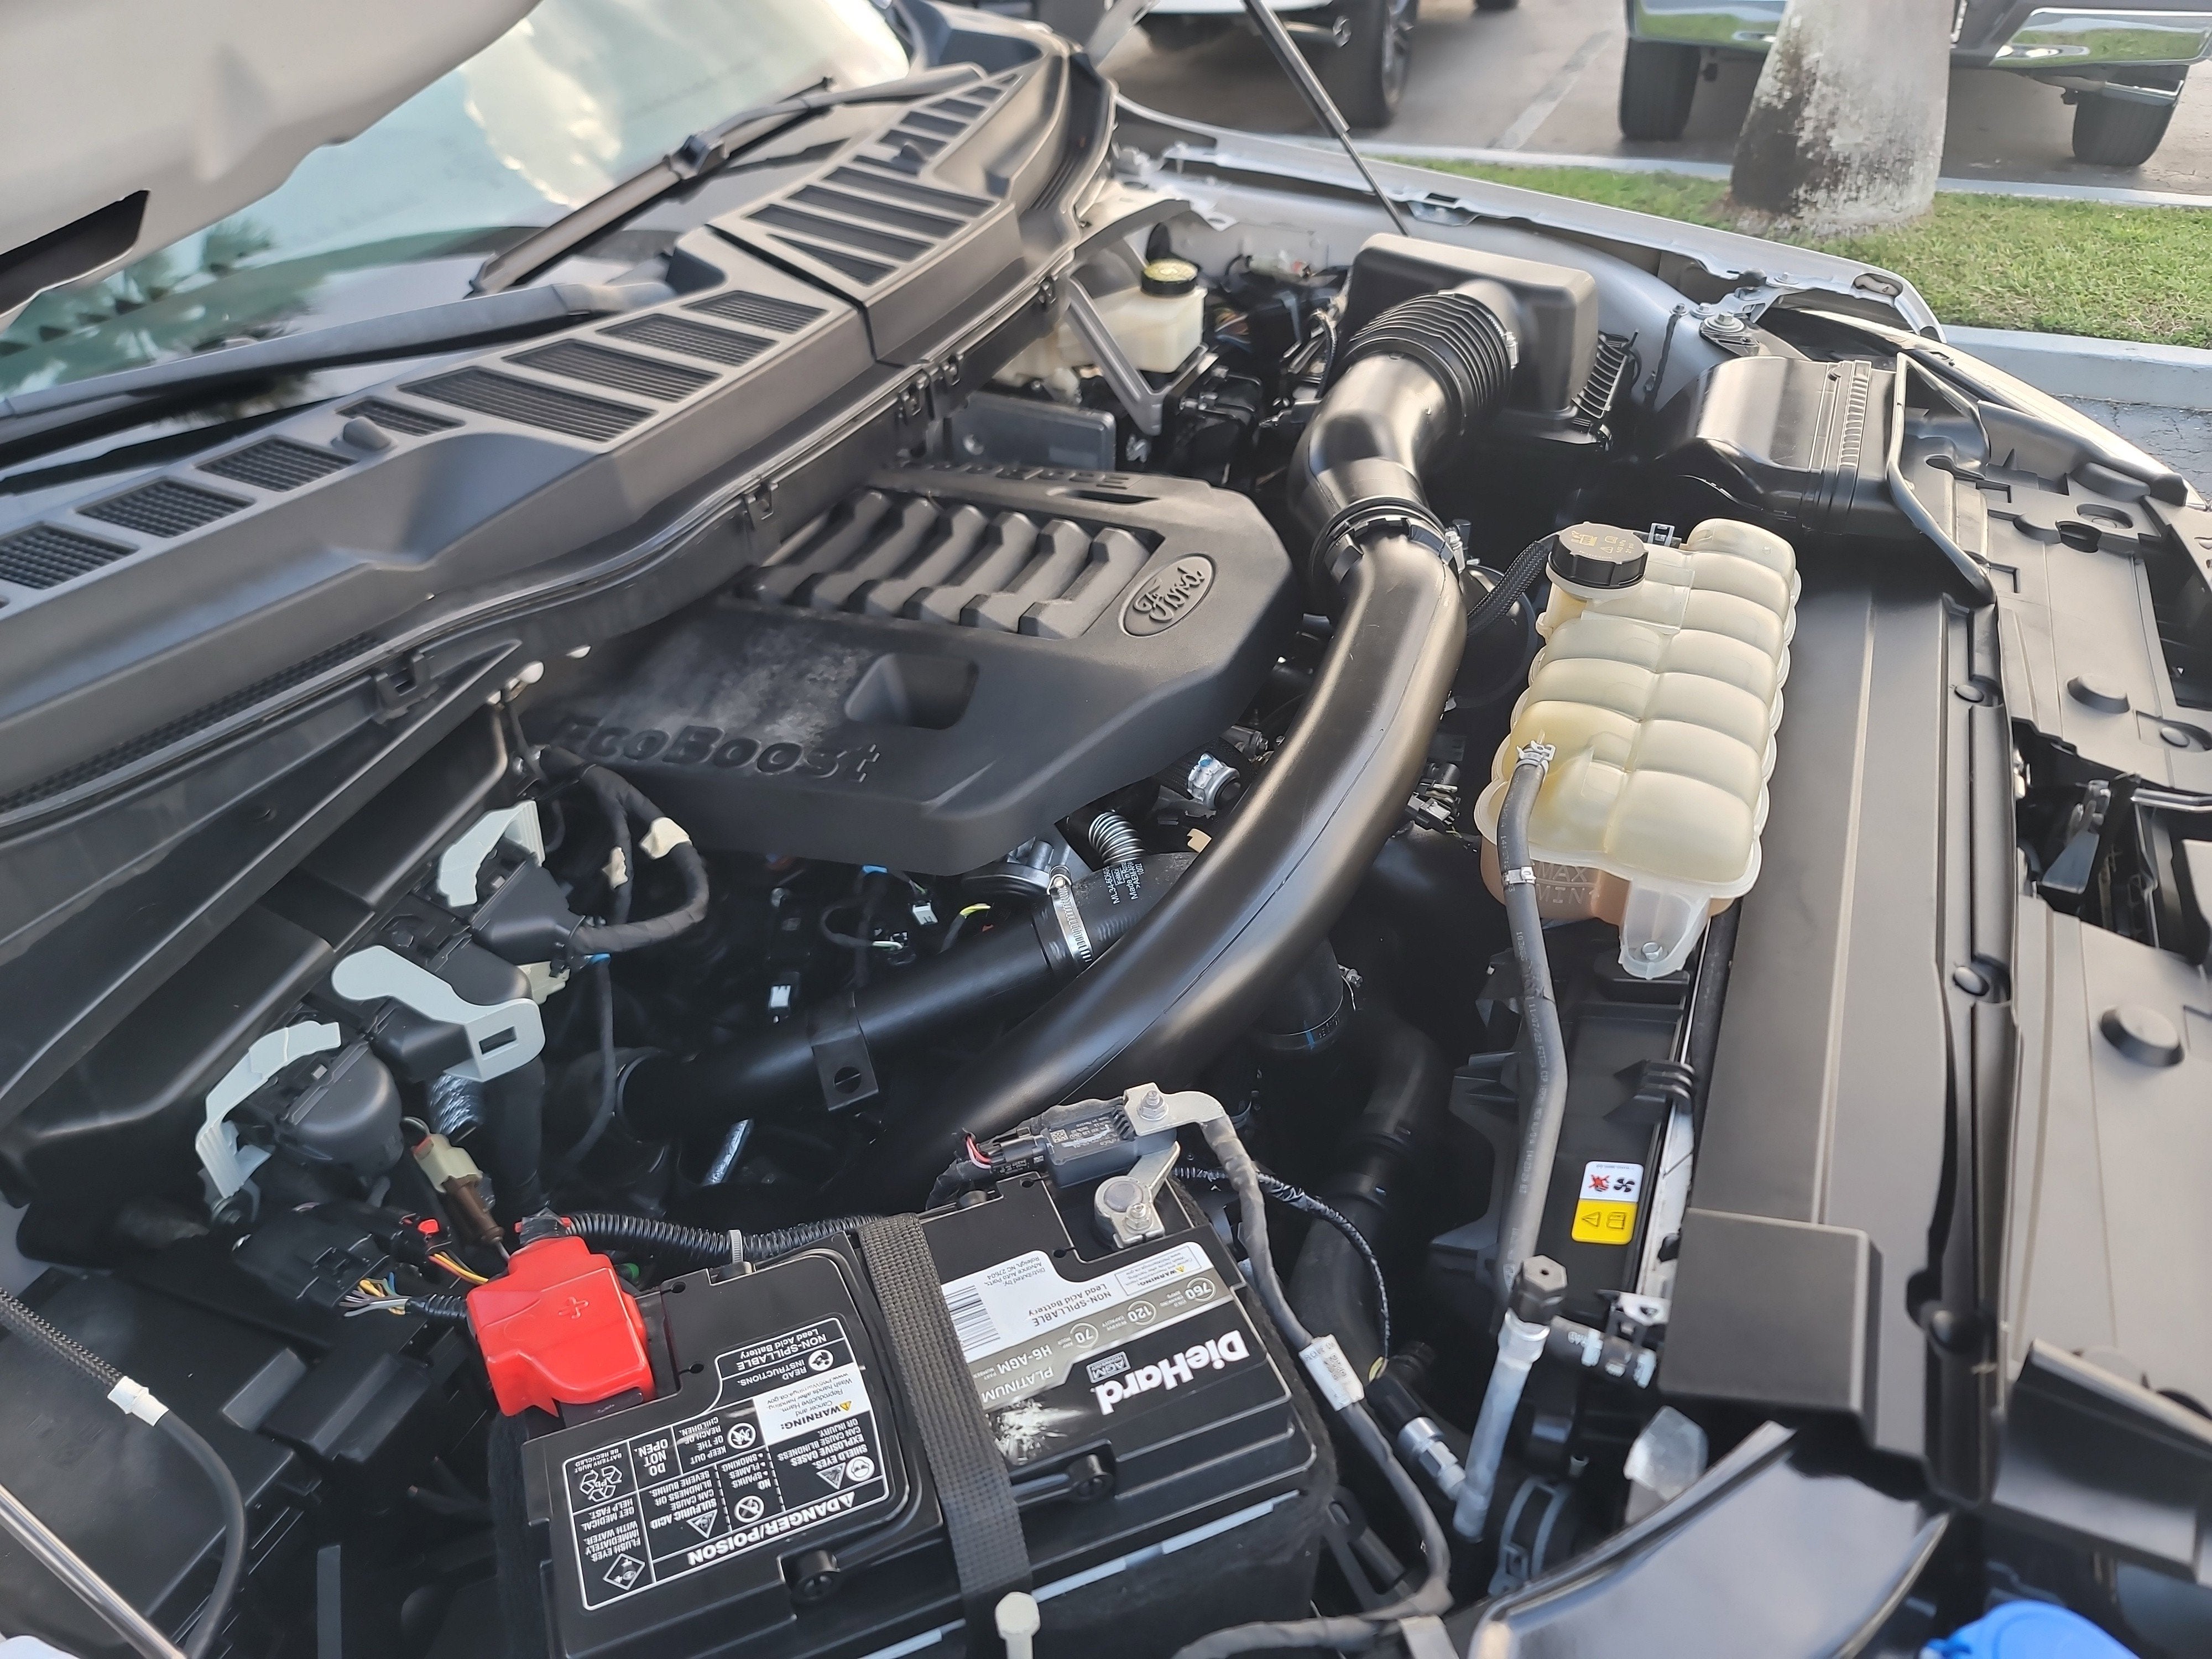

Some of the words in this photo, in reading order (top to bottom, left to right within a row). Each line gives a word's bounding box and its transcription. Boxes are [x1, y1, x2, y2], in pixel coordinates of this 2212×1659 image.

[1133, 565, 1205, 623] Ford
[1537, 860, 1587, 882] MAX
[1126, 884, 1139, 900] Made
[1536, 884, 1585, 904] MIN
[1002, 1271, 1016, 1280] Auto
[1013, 1267, 1045, 1283] Distributed
[1018, 1261, 1041, 1274] Advance
[1064, 1292, 1082, 1303] Acid
[1084, 1284, 1107, 1296] Lead
[1185, 1280, 1213, 1300] 760
[1029, 1300, 1063, 1316] Battery
[1032, 1291, 1111, 1326] NON-SPILLABLE
[1127, 1303, 1152, 1322] 120
[774, 1336, 794, 1349] Acid
[796, 1328, 818, 1342] Lead
[1074, 1328, 1095, 1343] 70
[737, 1334, 826, 1370] NON-SPILLABLE
[740, 1340, 773, 1363] Battery
[997, 1345, 1052, 1374] H6-AGM
[737, 1359, 804, 1386] INSTRUCTIONS.
[781, 1366, 807, 1380] READ
[1091, 1357, 1126, 1380] AGM
[1095, 1332, 1246, 1413] DieHard
[833, 1378, 852, 1387] Wash
[982, 1366, 1053, 1402] PLATINUM
[801, 1388, 843, 1406] Reproductive
[795, 1407, 807, 1417] and
[809, 1400, 832, 1411] Cancer
[781, 1406, 840, 1429] WARNING:
[846, 1418, 858, 1427] OR
[696, 1425, 721, 1439] REACH
[820, 1431, 844, 1446] CAUSE
[844, 1425, 861, 1437] CAN
[634, 1438, 668, 1457] OPEN.
[696, 1439, 712, 1451] THE
[712, 1434, 723, 1445] OF
[818, 1433, 864, 1456] EXPLOSIVE
[641, 1449, 666, 1467] NOT
[690, 1453, 706, 1464] OUT
[707, 1445, 726, 1458] KEEP
[777, 1441, 820, 1460] BLINDNESS
[790, 1450, 818, 1466] GASES
[837, 1444, 867, 1460] SHIELD
[575, 1451, 609, 1467] RECYCLED
[593, 1452, 622, 1467] BATTERY
[721, 1453, 758, 1472] SMOKING
[574, 1463, 592, 1473] MUST
[648, 1462, 665, 1476] DO
[728, 1462, 760, 1479] FLAMES
[593, 1477, 608, 1490] Pb
[680, 1470, 709, 1487] SEVERE
[731, 1471, 763, 1488] SPARKS
[757, 1478, 771, 1490] NO
[667, 1479, 712, 1501] BLINDNESS
[697, 1488, 714, 1501] CAN
[612, 1498, 633, 1511] HELP
[654, 1495, 667, 1506] OR
[670, 1495, 697, 1510] CAUSE
[619, 1506, 634, 1518] GET
[673, 1498, 717, 1520] SULFURIC
[581, 1512, 617, 1531] MEDICAL
[615, 1520, 638, 1535] WITH
[650, 1514, 672, 1529] ACID
[688, 1499, 839, 1564] DANGER/POISON
[586, 1528, 639, 1554] IMMEDIATELY
[613, 1537, 640, 1553] FLUSH
